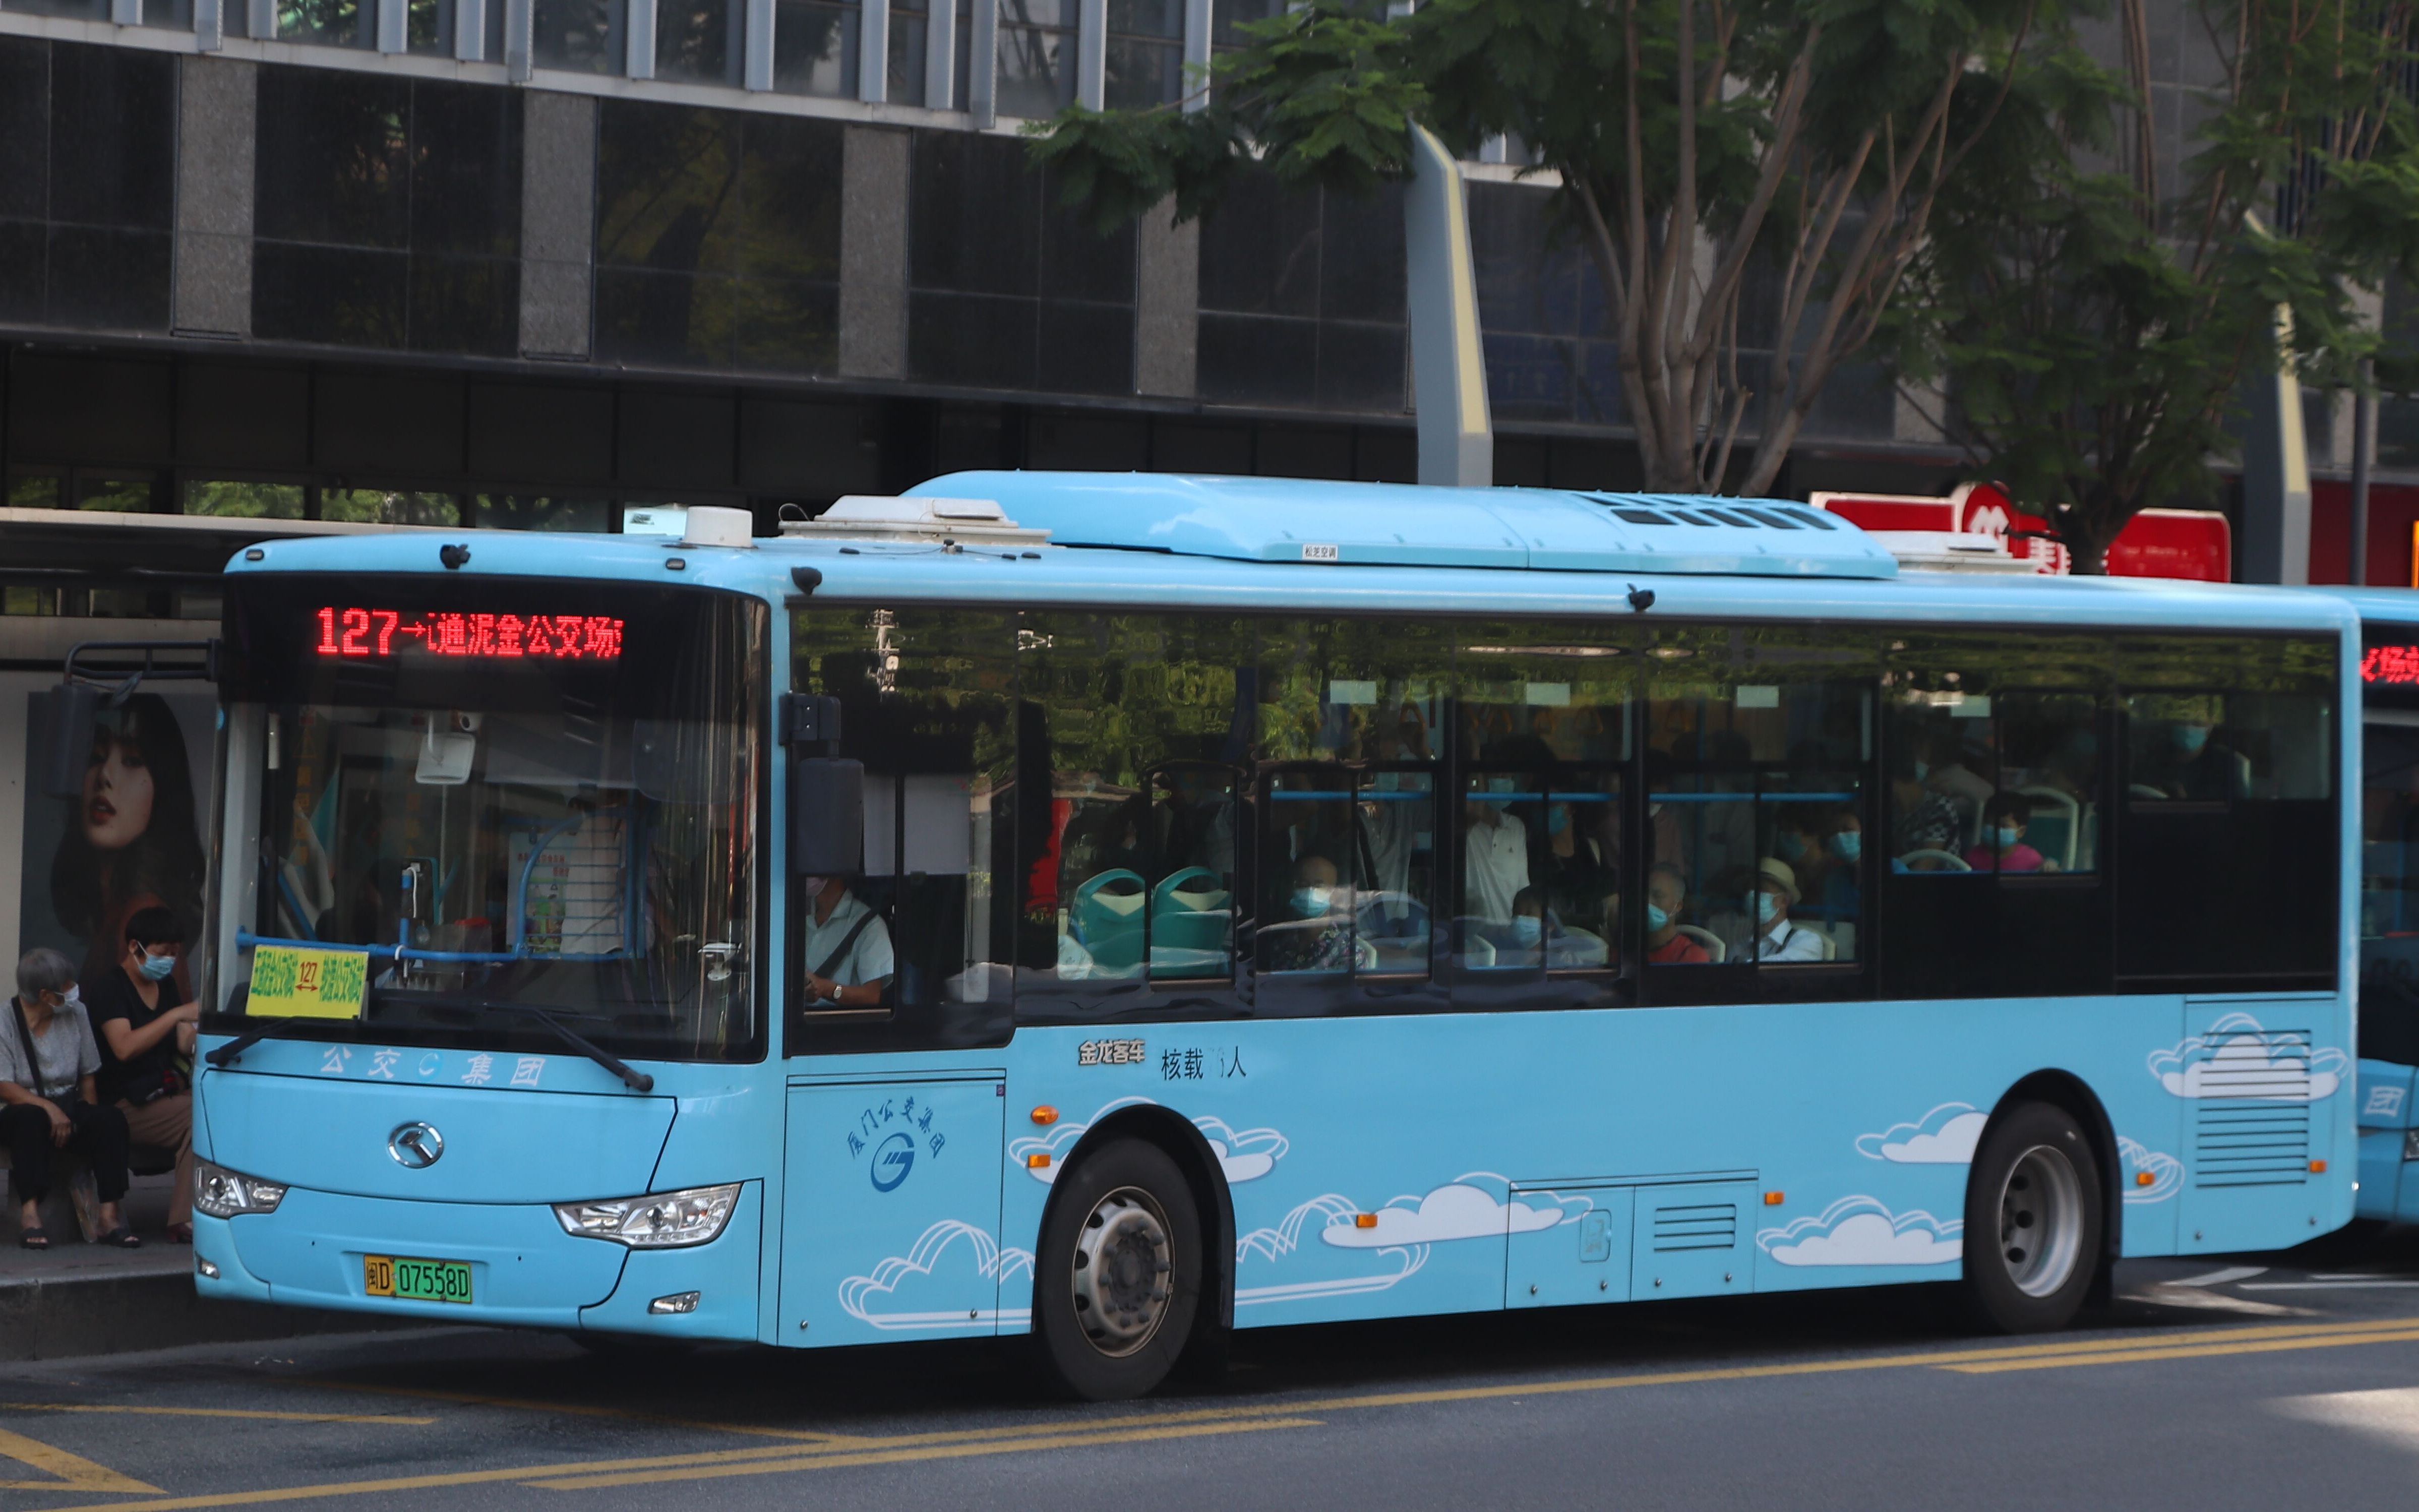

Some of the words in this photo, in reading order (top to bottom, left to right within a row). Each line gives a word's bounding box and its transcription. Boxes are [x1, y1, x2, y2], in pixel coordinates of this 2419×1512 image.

[318, 607, 398, 654] 127
[300, 961, 318, 983] 127
[1078, 1039, 1145, 1066] 金龙客车
